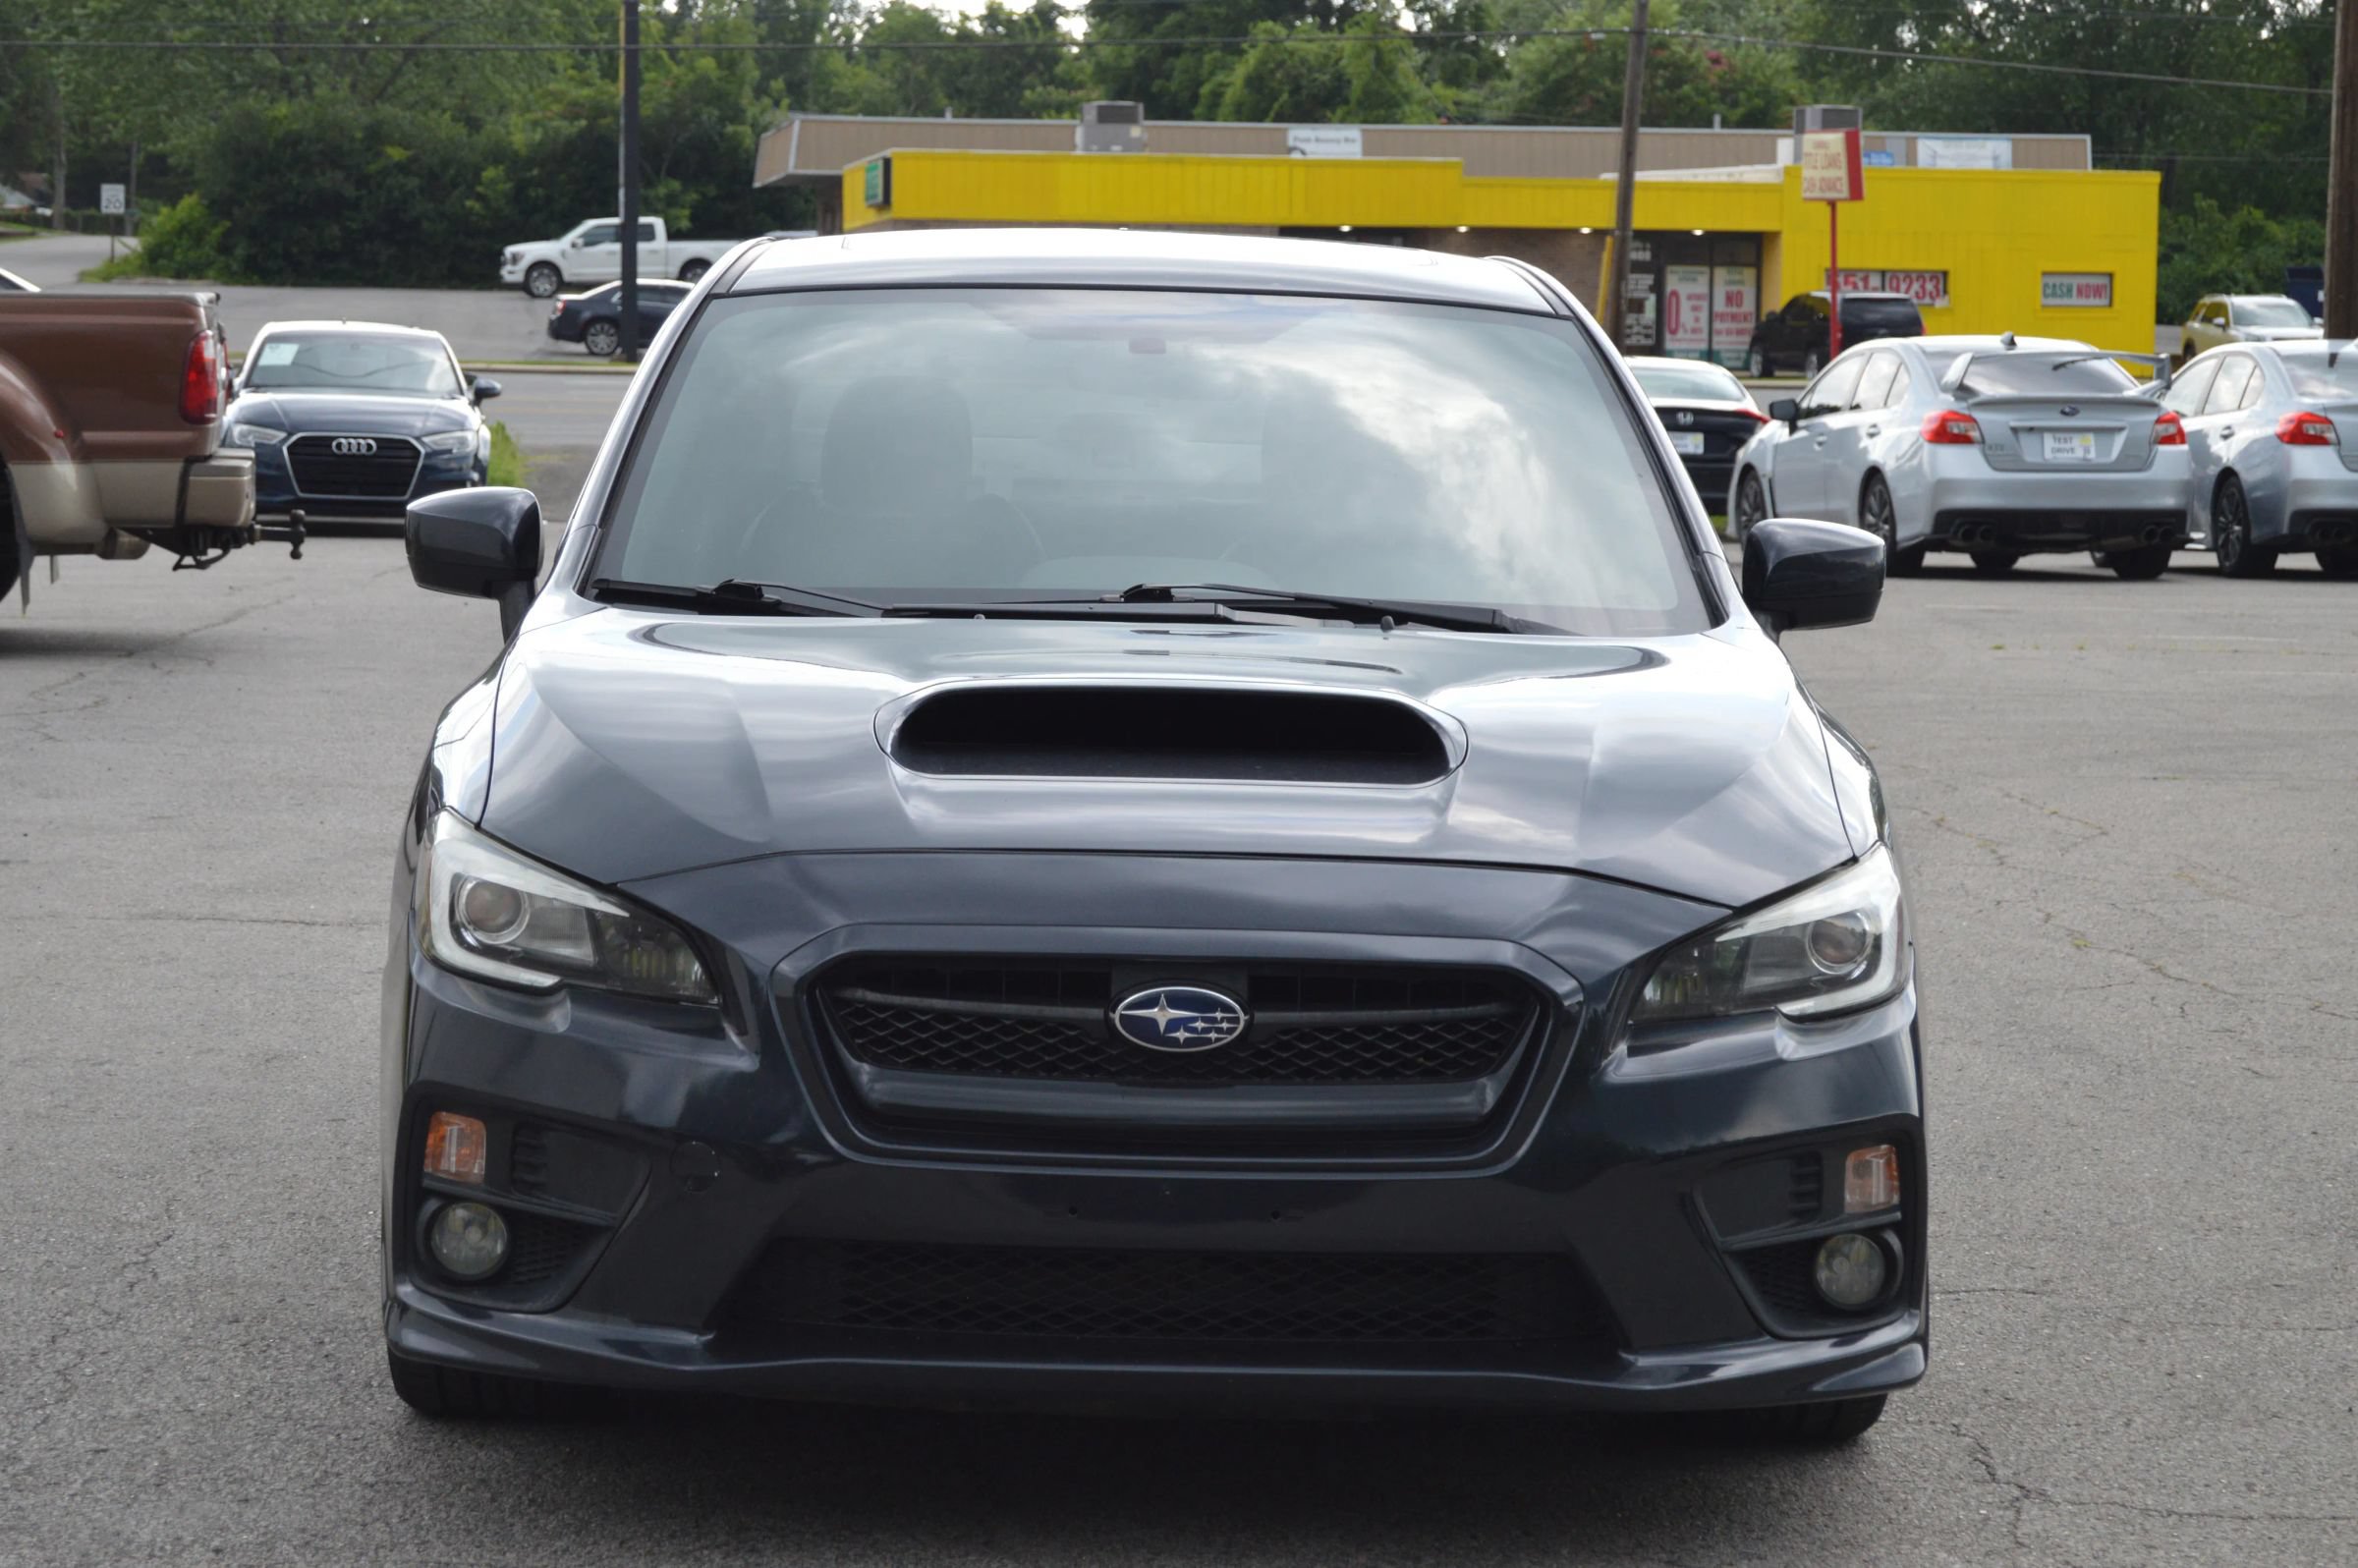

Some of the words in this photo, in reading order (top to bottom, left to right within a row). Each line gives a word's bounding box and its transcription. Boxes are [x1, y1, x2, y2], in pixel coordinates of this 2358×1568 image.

[104, 197, 122, 209] 20
[1888, 273, 1940, 301] 9233
[2043, 282, 2073, 299] CASH
[2076, 282, 2108, 299] NOW!
[1724, 290, 1744, 308] NO
[2052, 433, 2074, 445] TEST
[2051, 446, 2076, 455] DRIVE
